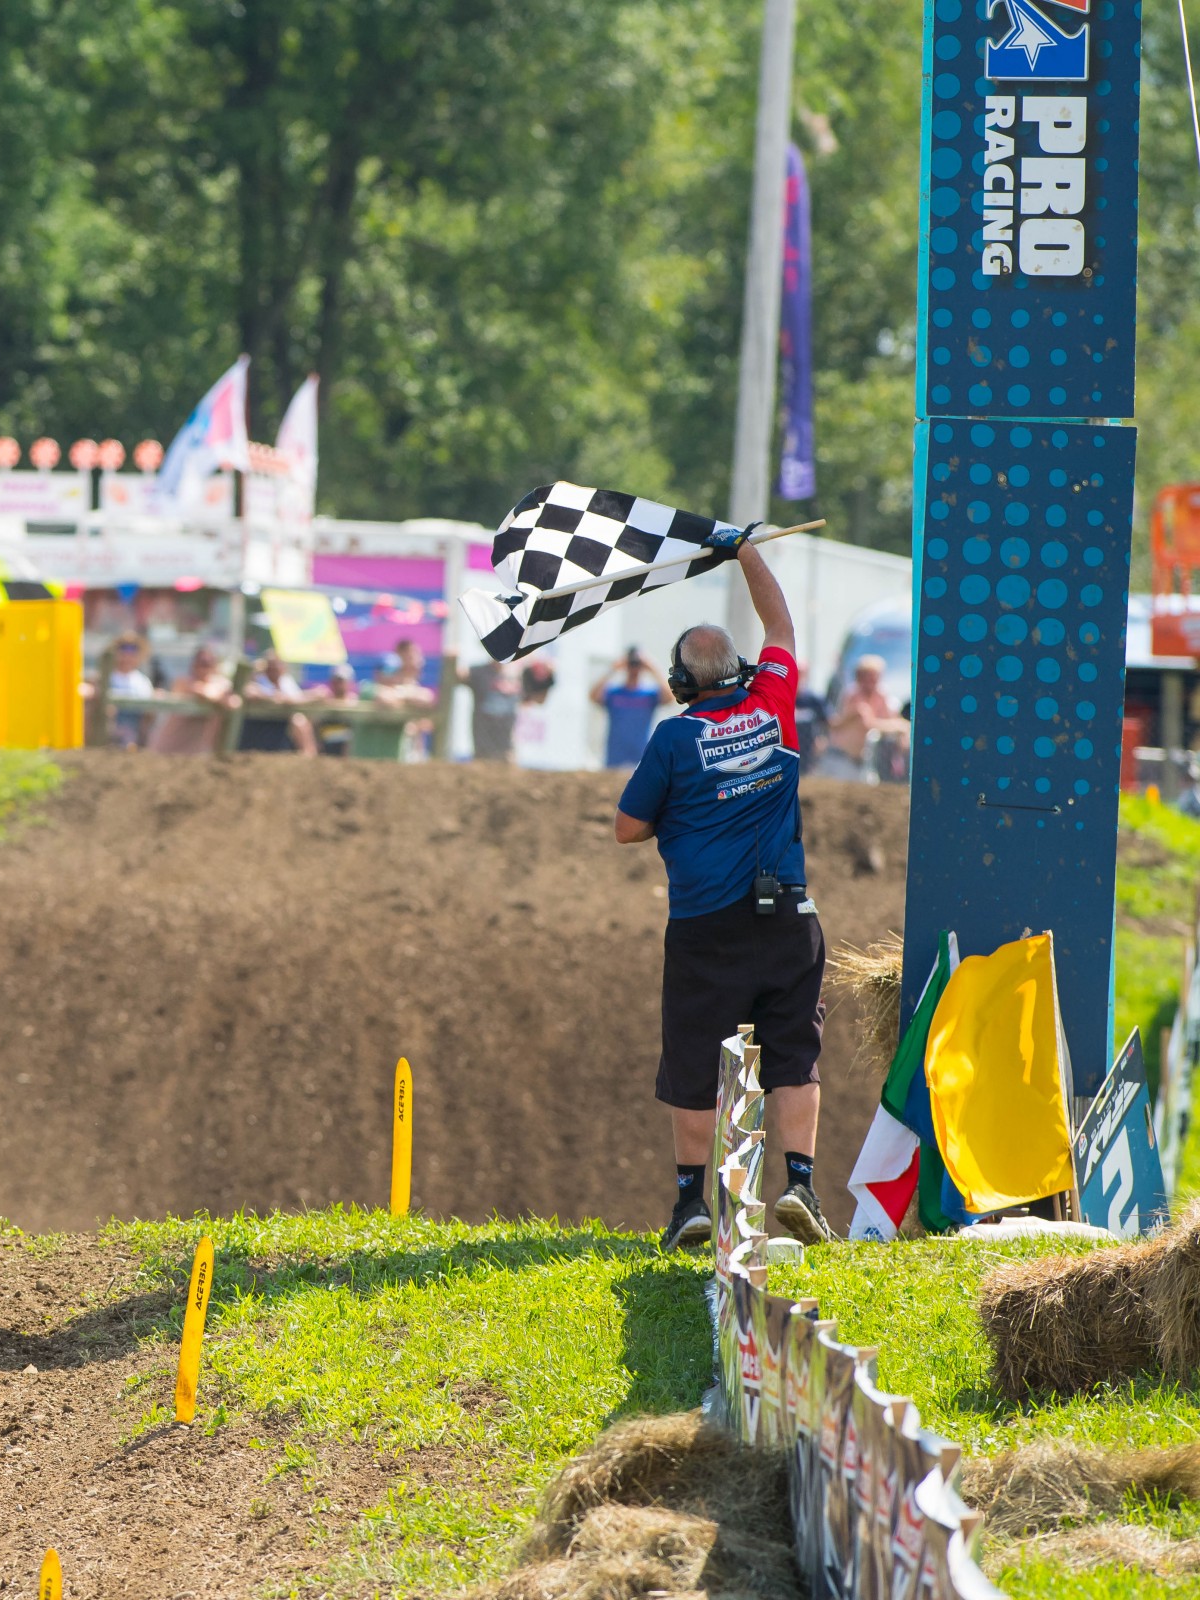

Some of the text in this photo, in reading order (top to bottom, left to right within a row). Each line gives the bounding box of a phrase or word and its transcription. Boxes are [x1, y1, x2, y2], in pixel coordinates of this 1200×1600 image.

[982, 95, 1015, 275] RACING
[1019, 96, 1088, 276] PRO
[704, 728, 779, 758] MOTOCROSS
[710, 714, 762, 738] LUCAS OIL
[731, 781, 756, 797] NBC
[398, 1079, 406, 1123] ACERBIS
[195, 1261, 207, 1311] ACERBIS
